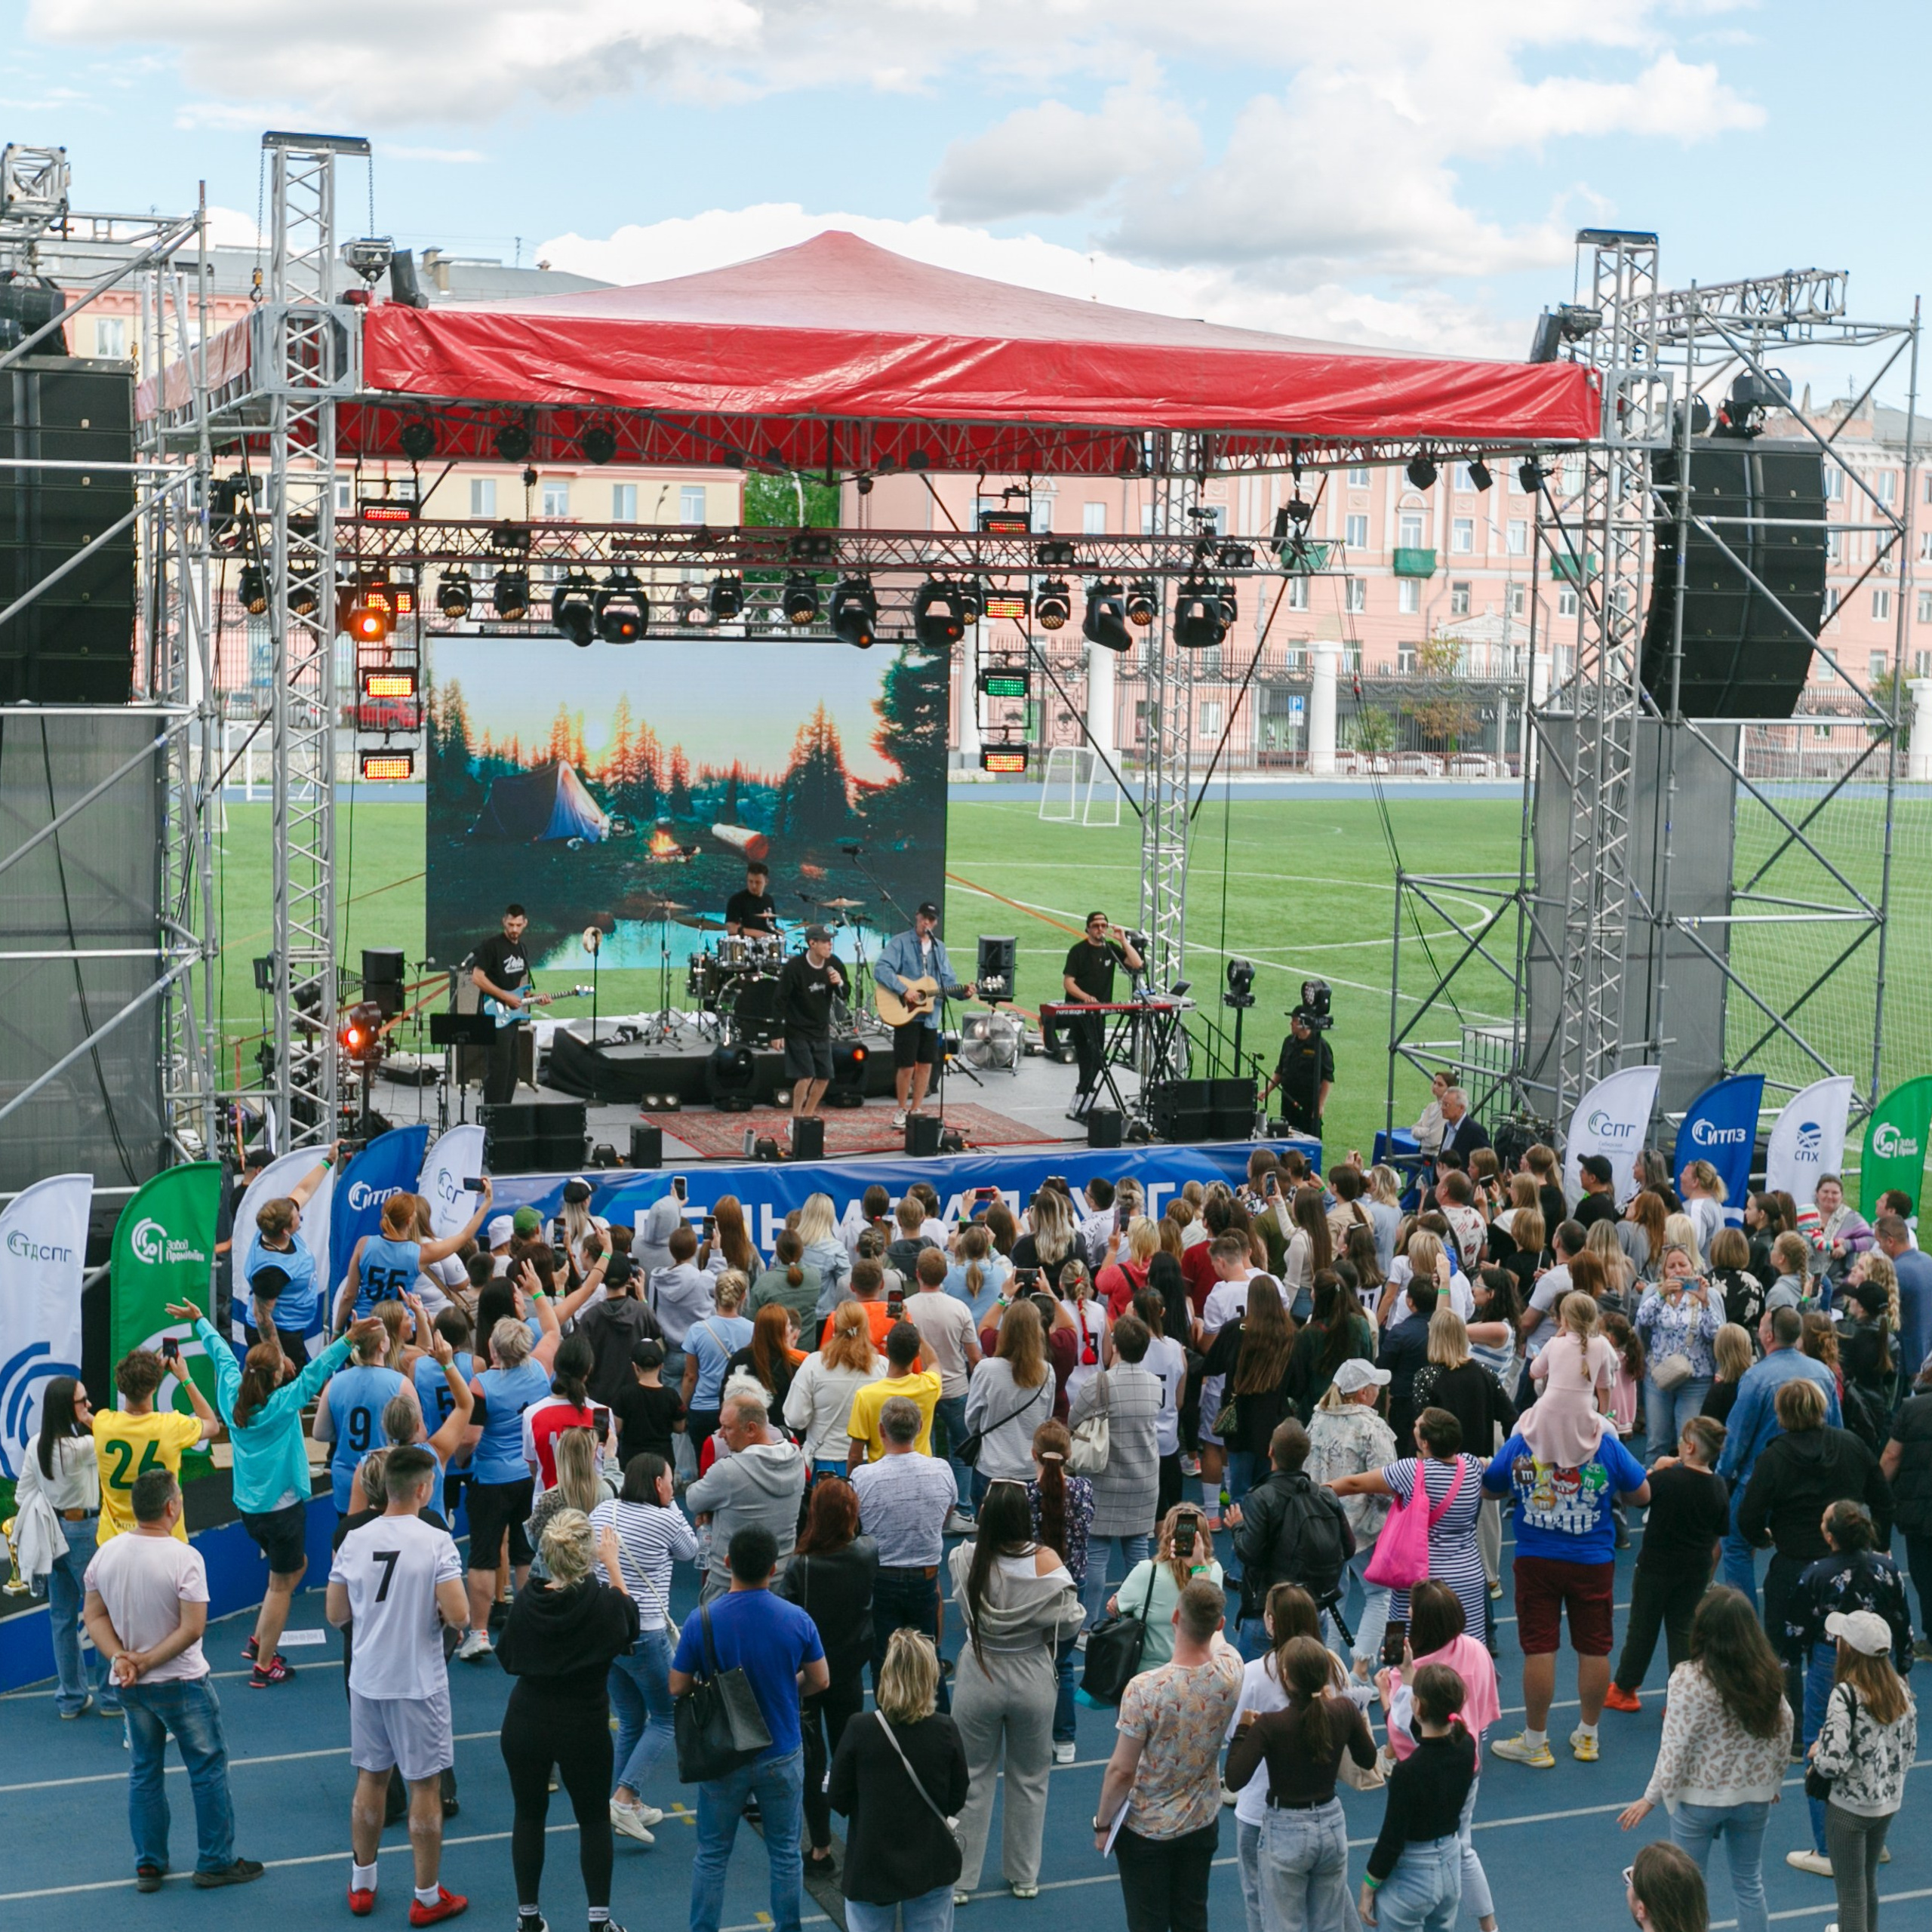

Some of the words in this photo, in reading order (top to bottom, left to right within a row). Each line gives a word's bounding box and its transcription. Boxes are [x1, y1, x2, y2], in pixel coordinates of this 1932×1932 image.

[1601, 1122, 1636, 1137] СПГ
[1707, 1128, 1746, 1146] ИТПЗ
[1794, 1150, 1820, 1162] СПХ
[365, 1266, 408, 1301] 55
[349, 1407, 371, 1451] 9
[105, 1439, 166, 1490] 26
[373, 1550, 401, 1602] 7
